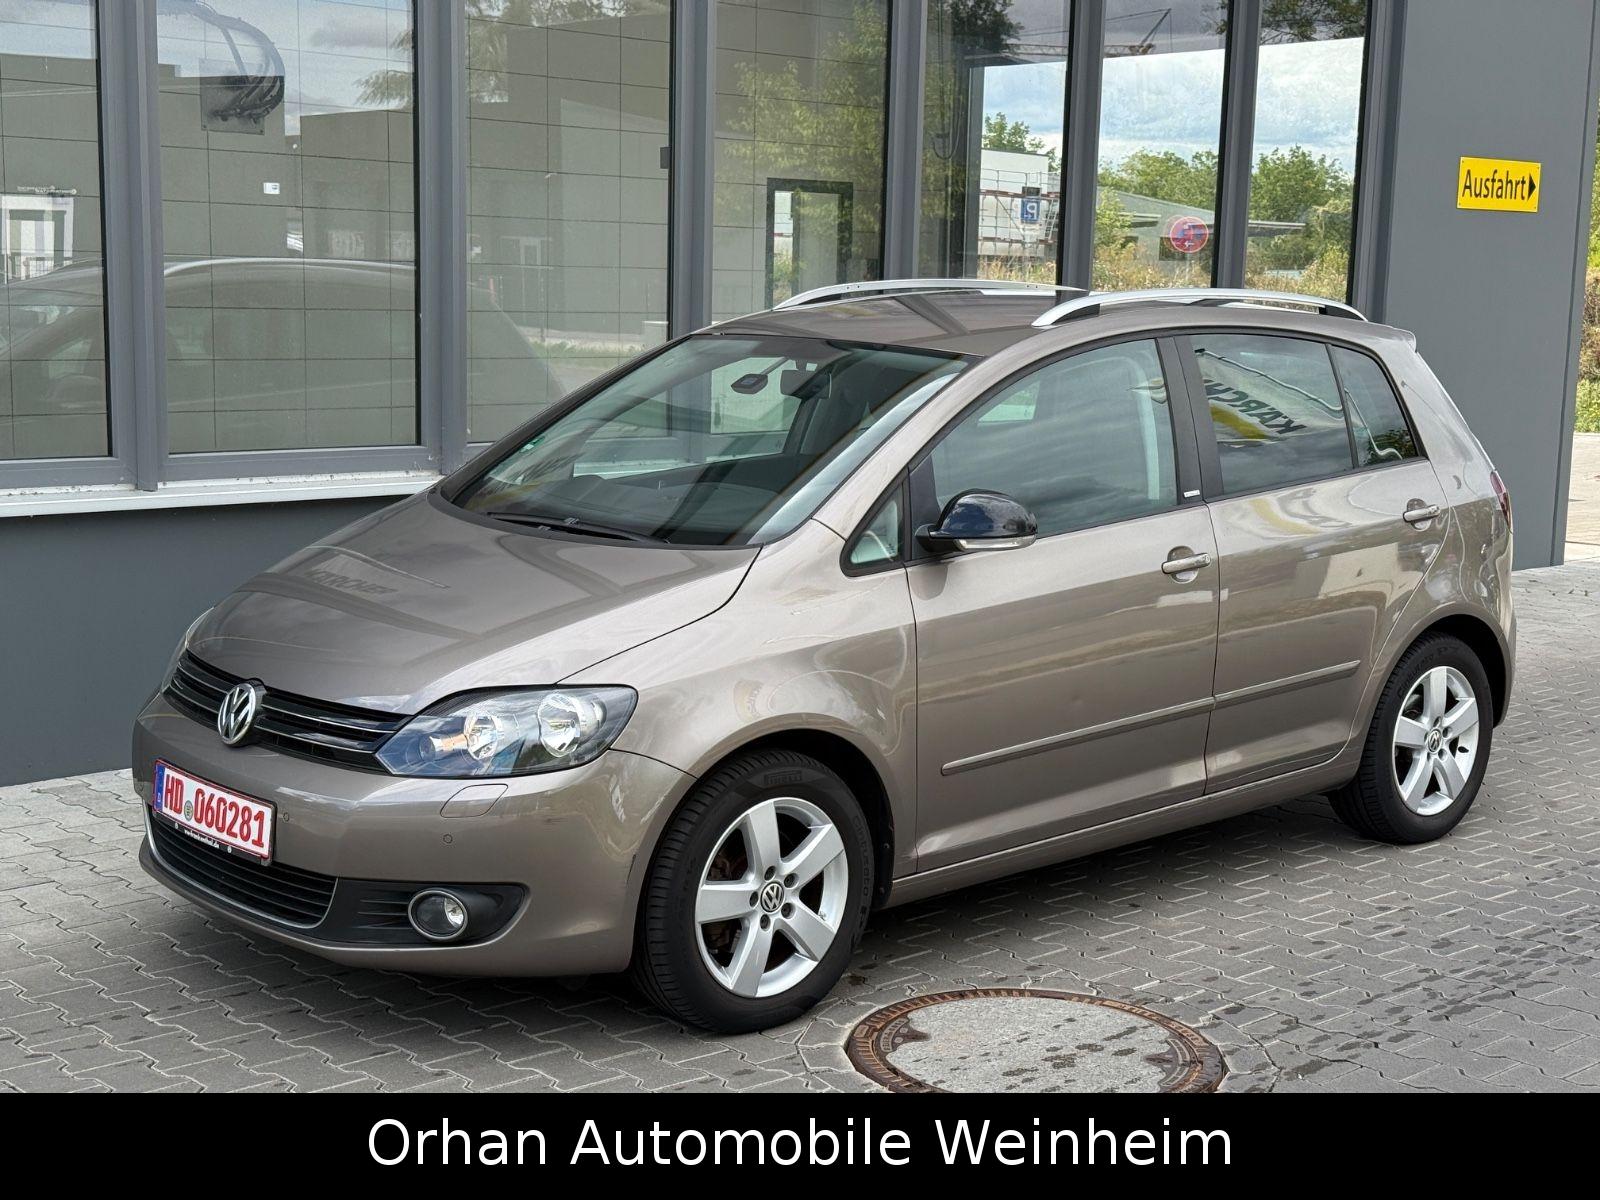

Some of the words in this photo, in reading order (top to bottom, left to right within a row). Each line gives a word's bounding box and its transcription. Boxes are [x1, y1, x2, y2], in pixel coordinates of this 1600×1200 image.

[1462, 169, 1526, 200] Ausfahrt
[217, 683, 257, 745] VW
[164, 773, 184, 815] HD
[193, 788, 265, 848] 060281
